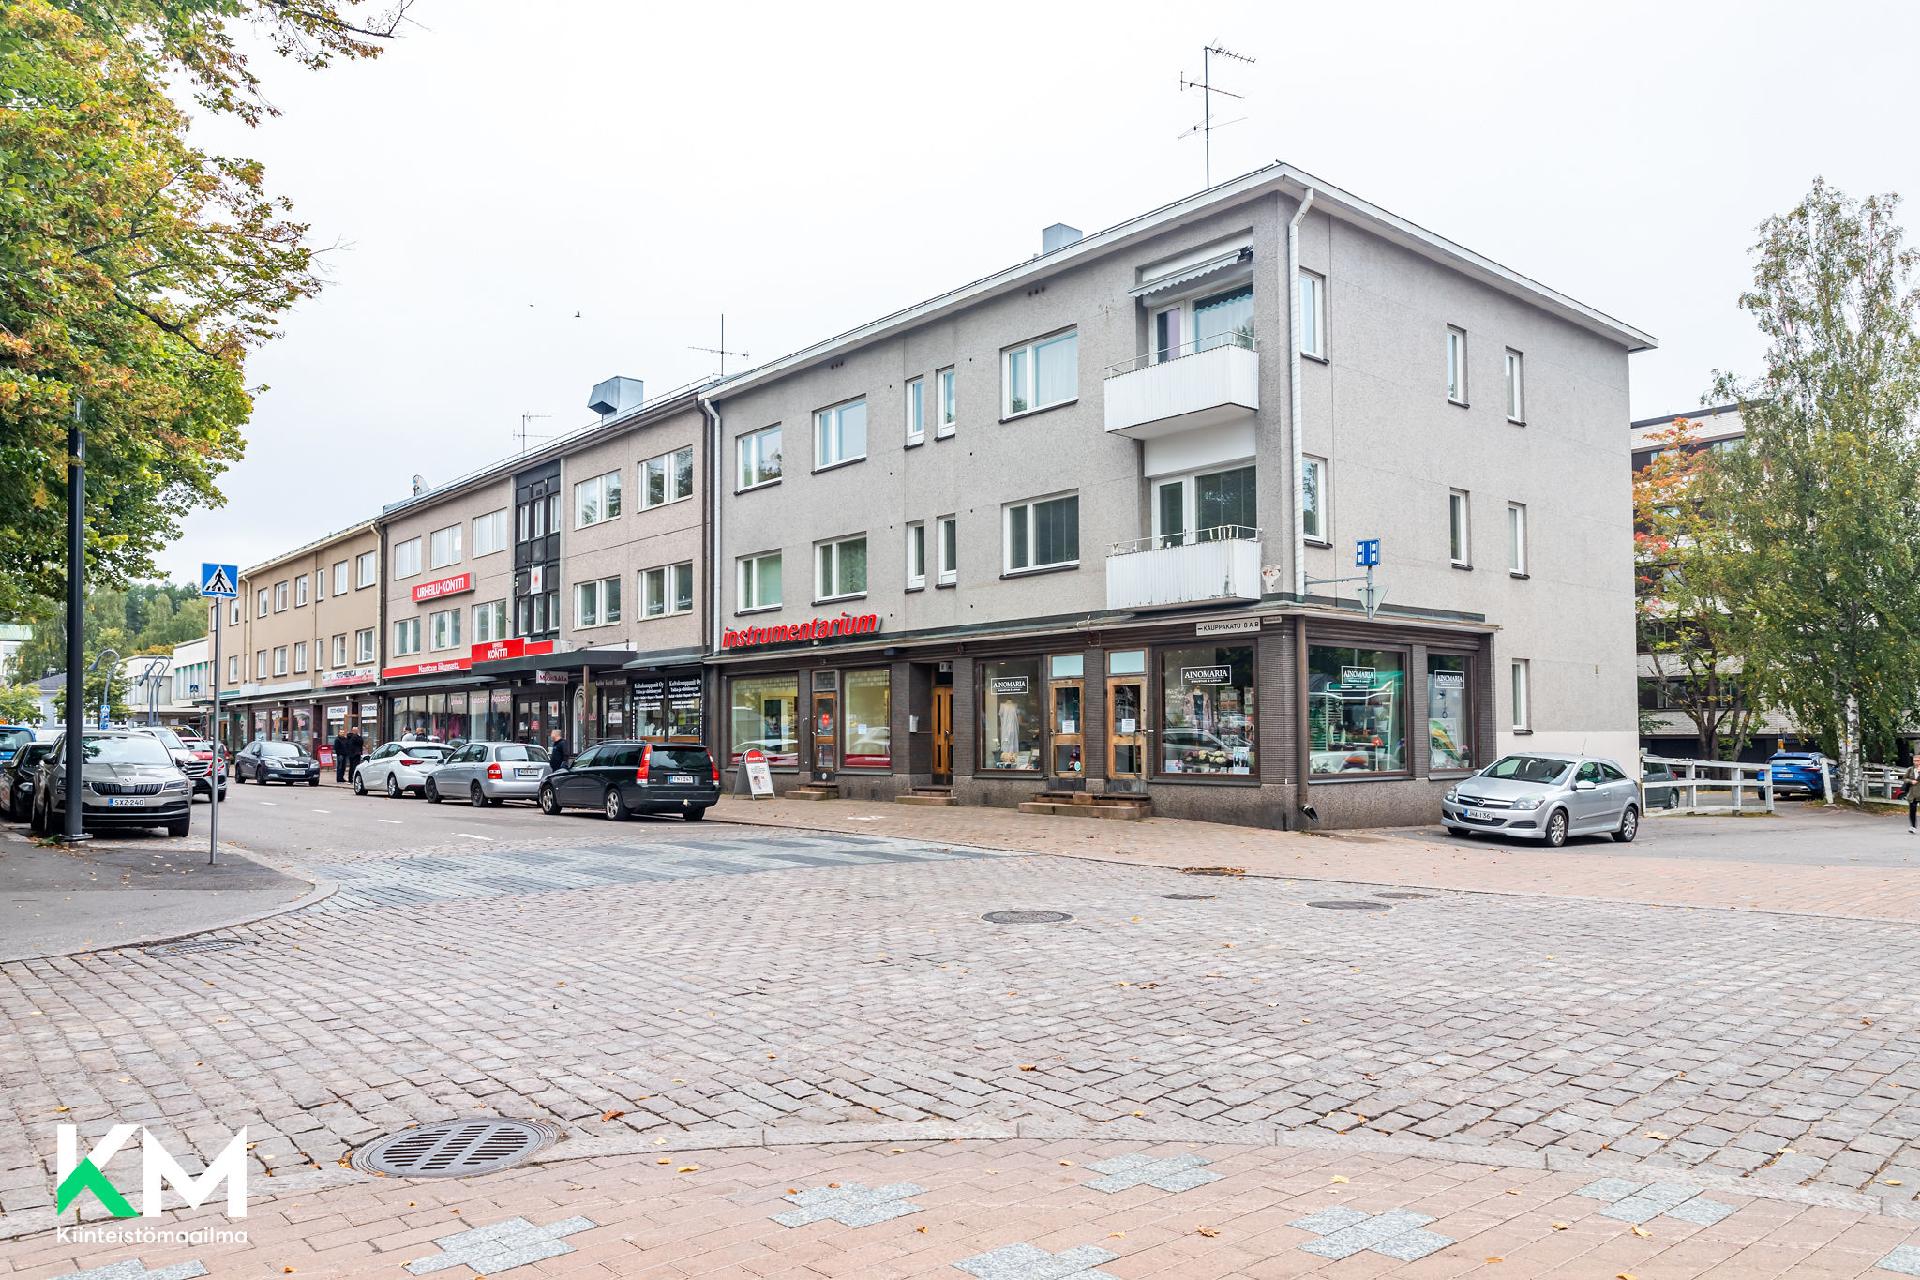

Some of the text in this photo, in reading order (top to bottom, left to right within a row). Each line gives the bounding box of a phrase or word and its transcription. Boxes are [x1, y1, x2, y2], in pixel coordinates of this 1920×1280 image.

[722, 612, 879, 649] instrumentarium
[1203, 623, 1241, 631] KAUPPAKATU
[487, 648, 508, 660] KONTTI
[1184, 669, 1228, 679] AINOMARIA
[1343, 670, 1374, 679] AINOMARIA
[1437, 674, 1463, 682] AINOMARIA
